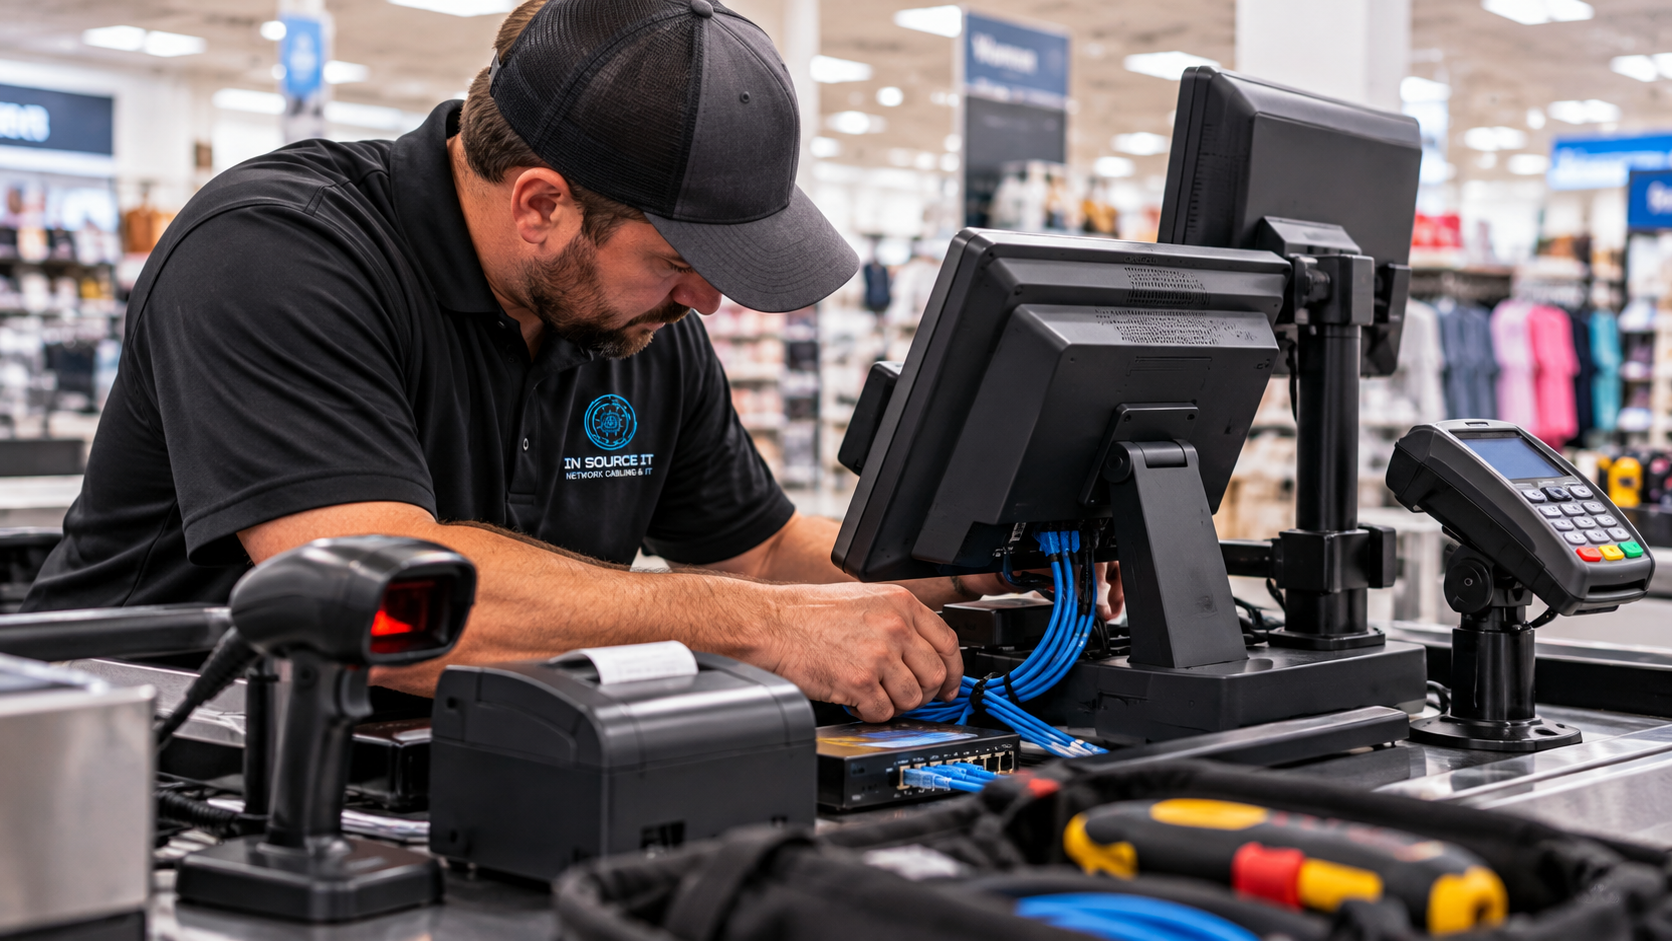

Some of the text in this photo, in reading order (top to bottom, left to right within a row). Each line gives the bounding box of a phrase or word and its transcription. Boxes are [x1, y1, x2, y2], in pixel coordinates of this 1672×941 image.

[564, 454, 654, 469] IN SOURCE IT
[566, 471, 604, 480] NETWORK
[605, 468, 636, 477] CABLING
[645, 467, 653, 475] IT
